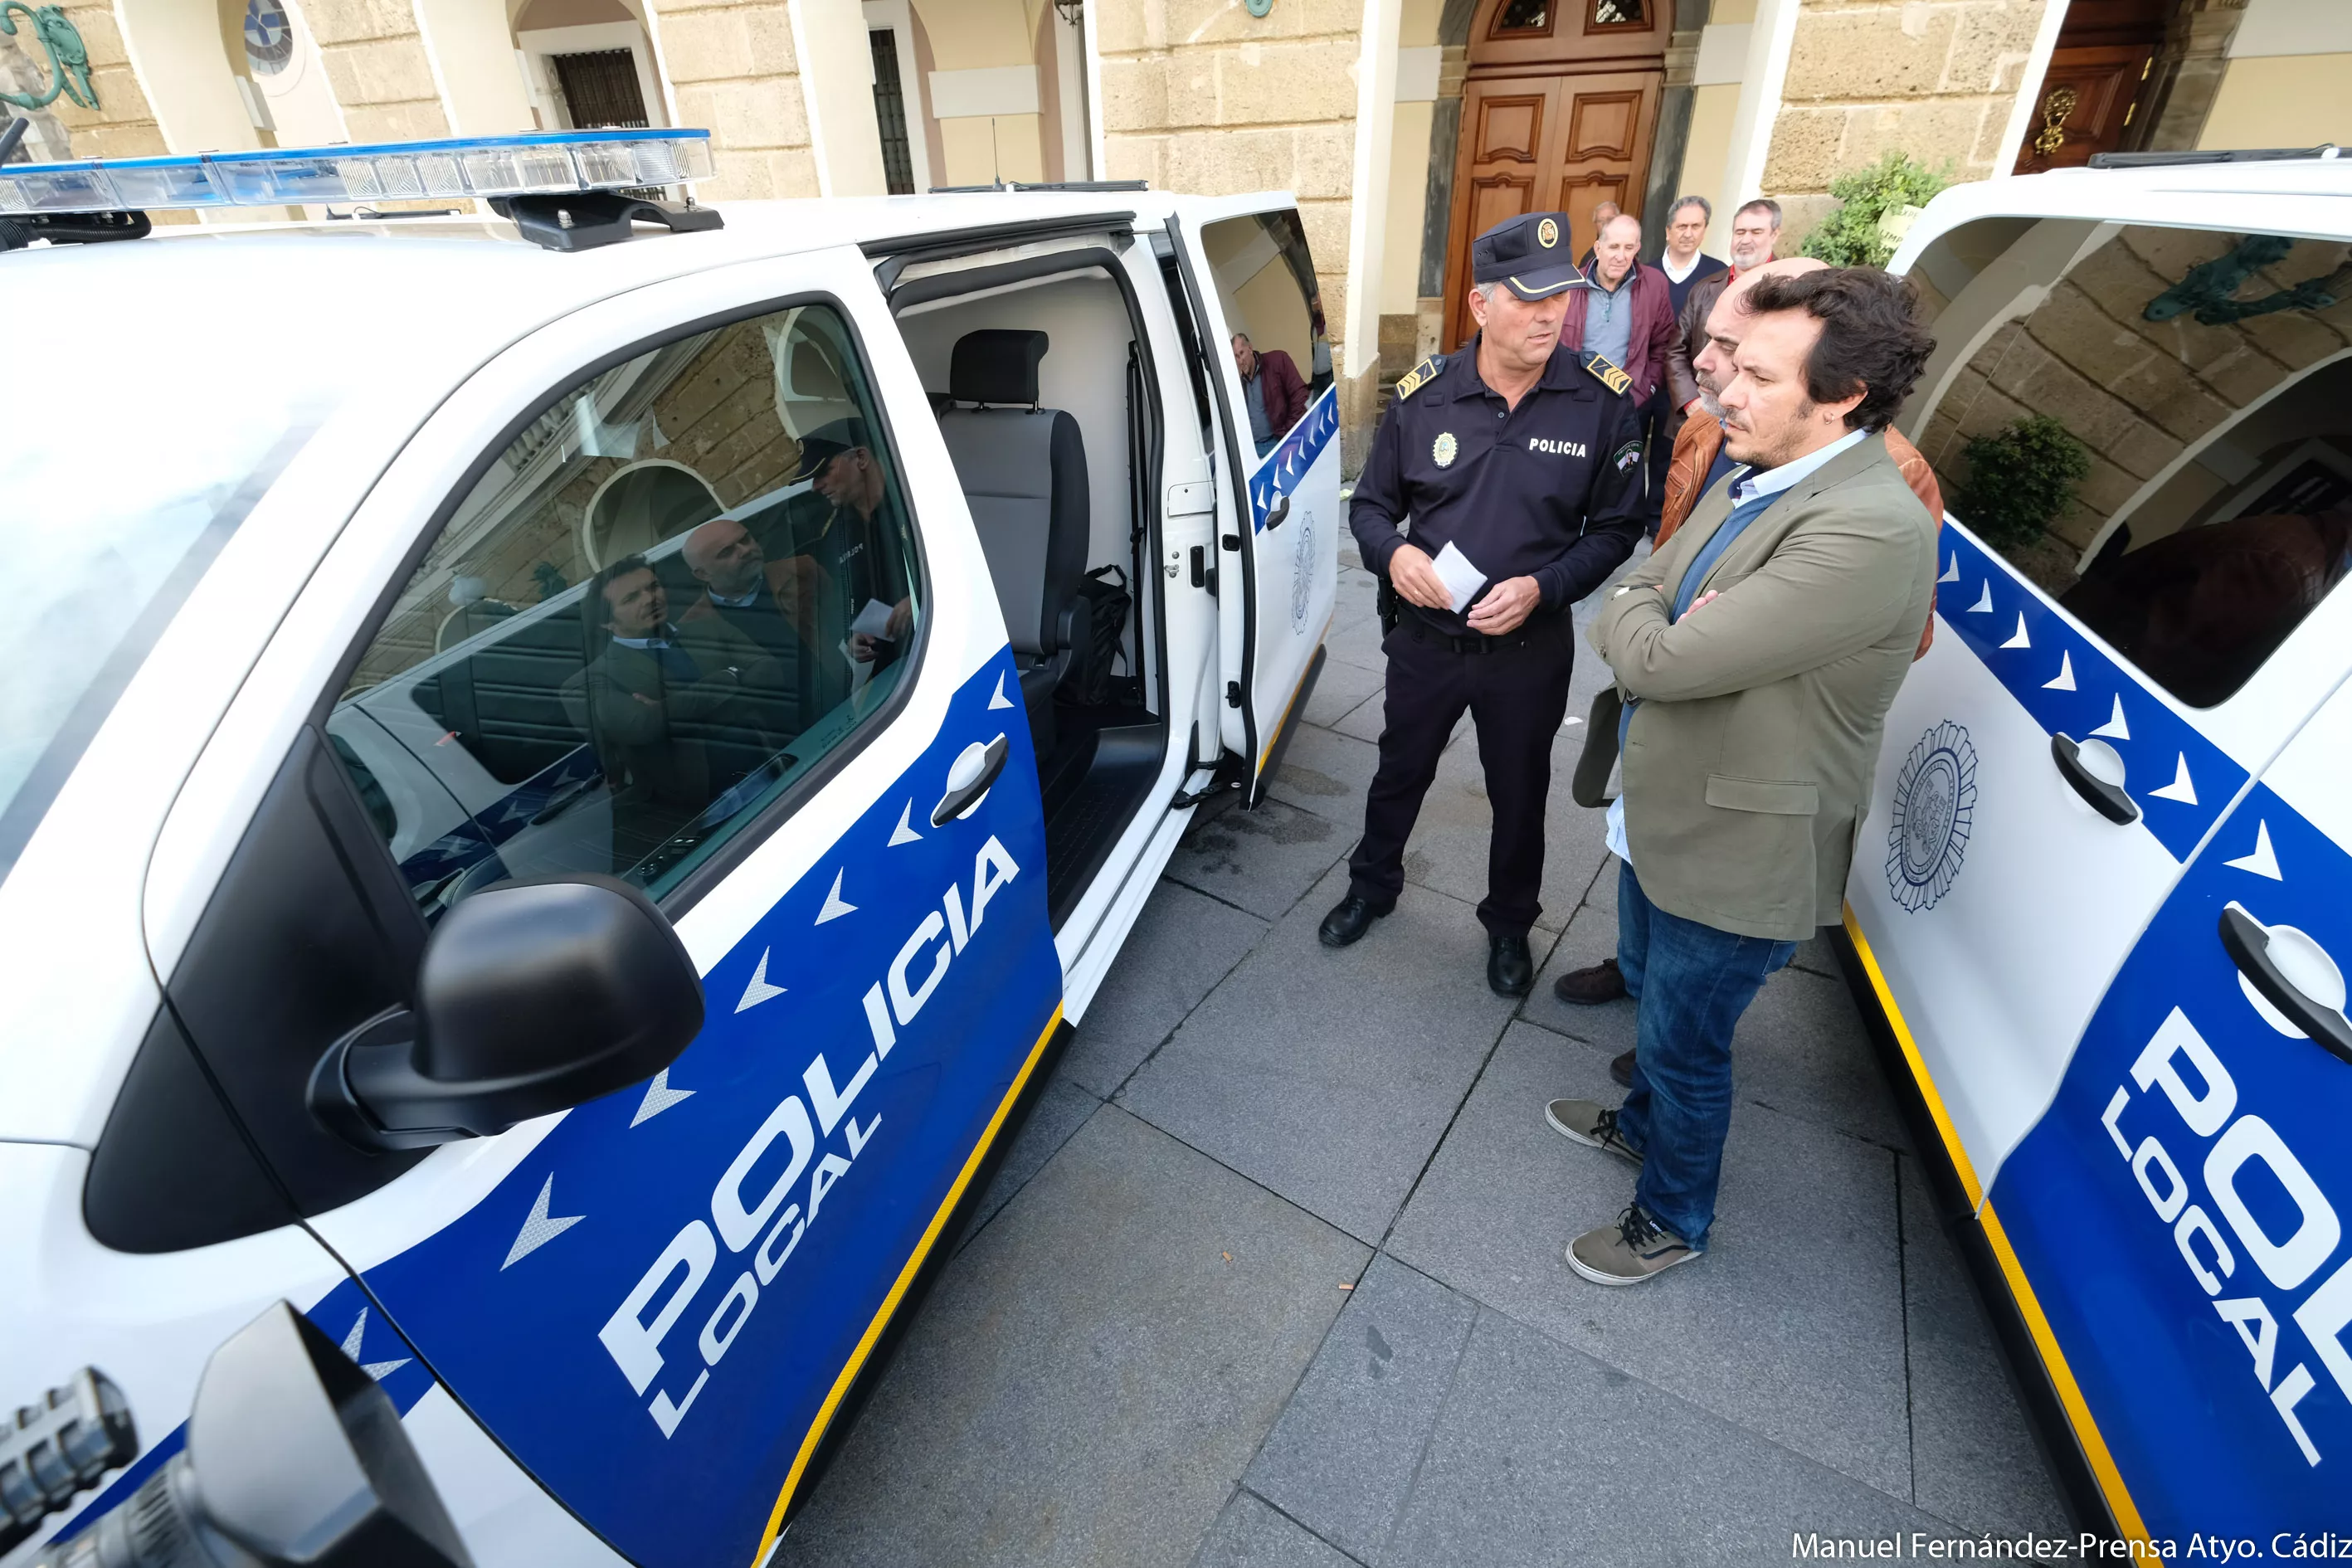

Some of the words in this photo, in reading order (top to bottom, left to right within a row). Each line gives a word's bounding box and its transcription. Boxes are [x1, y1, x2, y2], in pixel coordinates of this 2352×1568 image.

[1528, 437, 1586, 458] POLICIA
[598, 834, 1020, 1397] POLICIA
[648, 1111, 883, 1440] LOCAL
[2100, 1083, 2323, 1468] LOCAL
